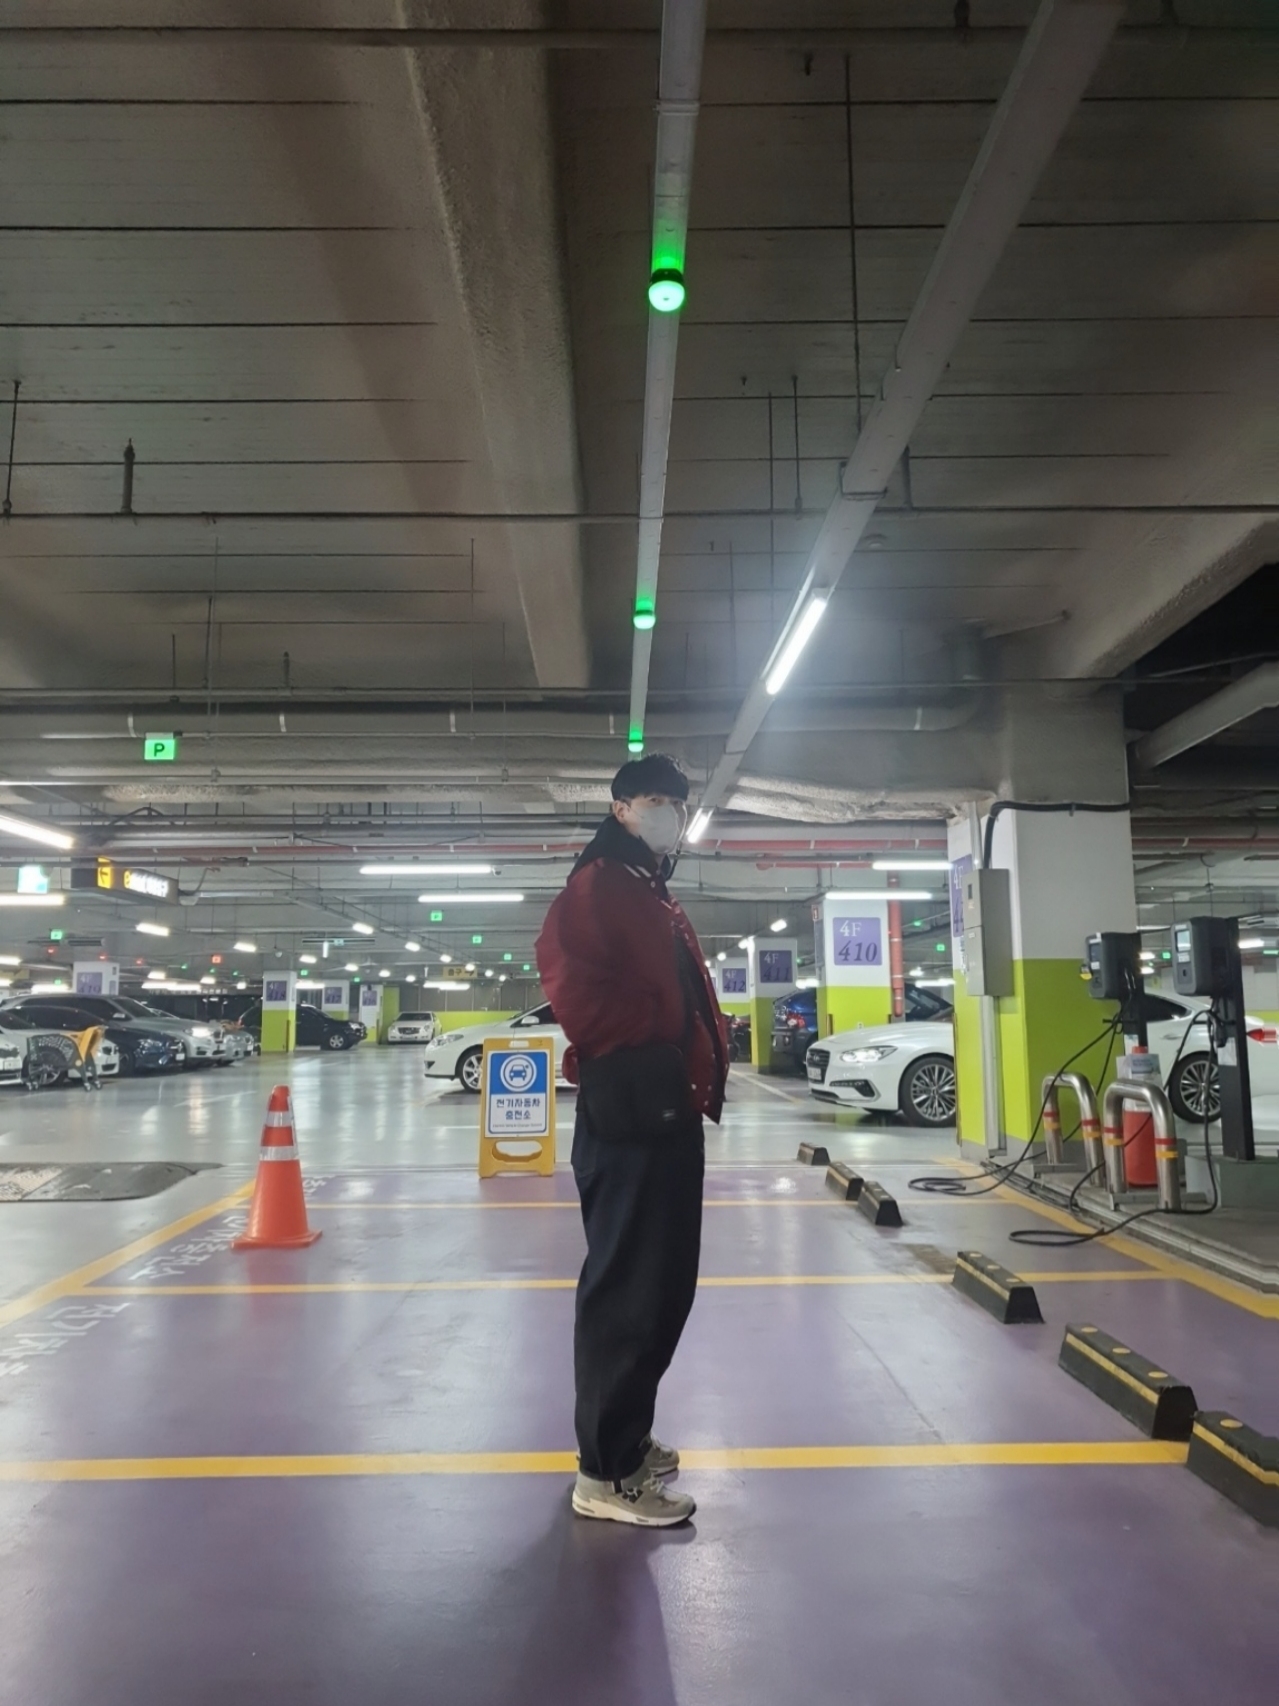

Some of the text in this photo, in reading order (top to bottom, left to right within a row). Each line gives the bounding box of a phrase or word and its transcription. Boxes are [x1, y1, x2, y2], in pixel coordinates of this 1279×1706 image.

[153, 742, 165, 757] P
[839, 920, 862, 937] 4F
[764, 952, 779, 964] 4F
[838, 940, 878, 963] 410
[763, 965, 791, 981] 411
[724, 980, 746, 992] 412
[496, 1098, 541, 1108] 전기자동차
